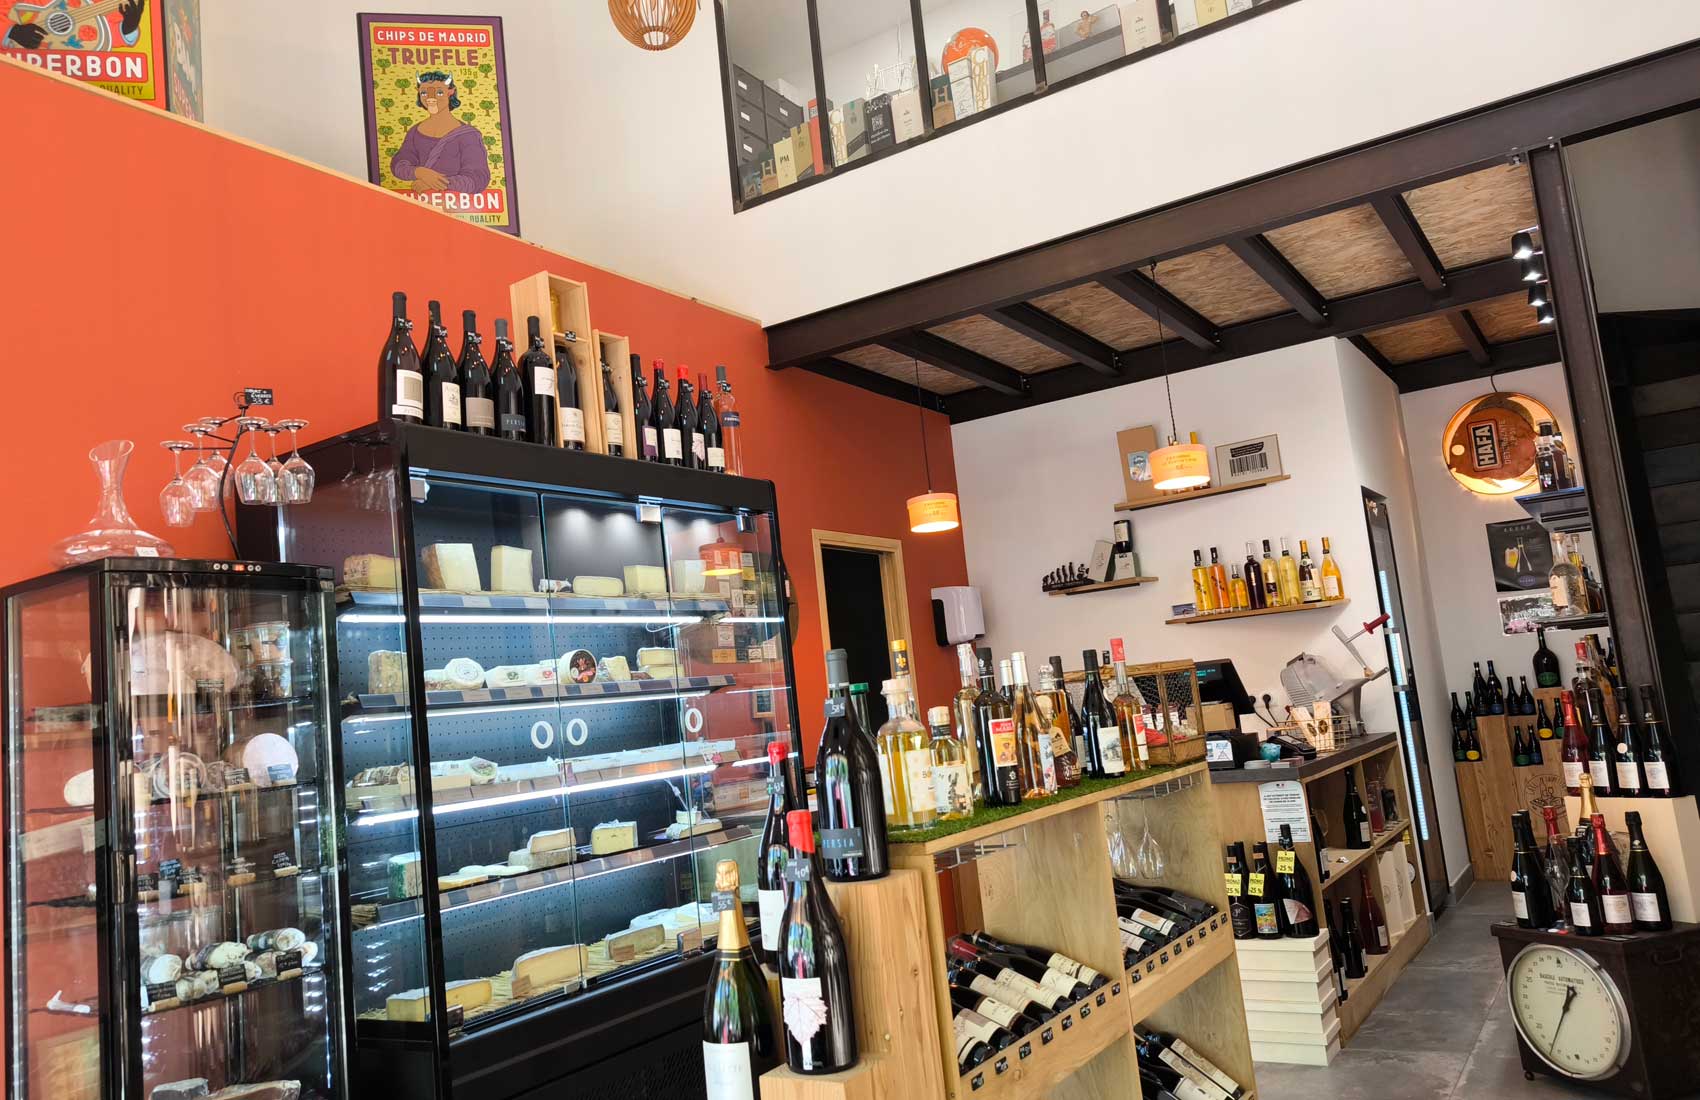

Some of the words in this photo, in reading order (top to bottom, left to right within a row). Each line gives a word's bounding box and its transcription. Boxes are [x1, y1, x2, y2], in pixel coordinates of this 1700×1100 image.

[377, 30, 415, 41] CHIPS
[419, 31, 435, 42] DE
[438, 32, 487, 43] MADRID
[388, 48, 479, 67] TRUFFLE
[1475, 425, 1495, 465] HAFA
